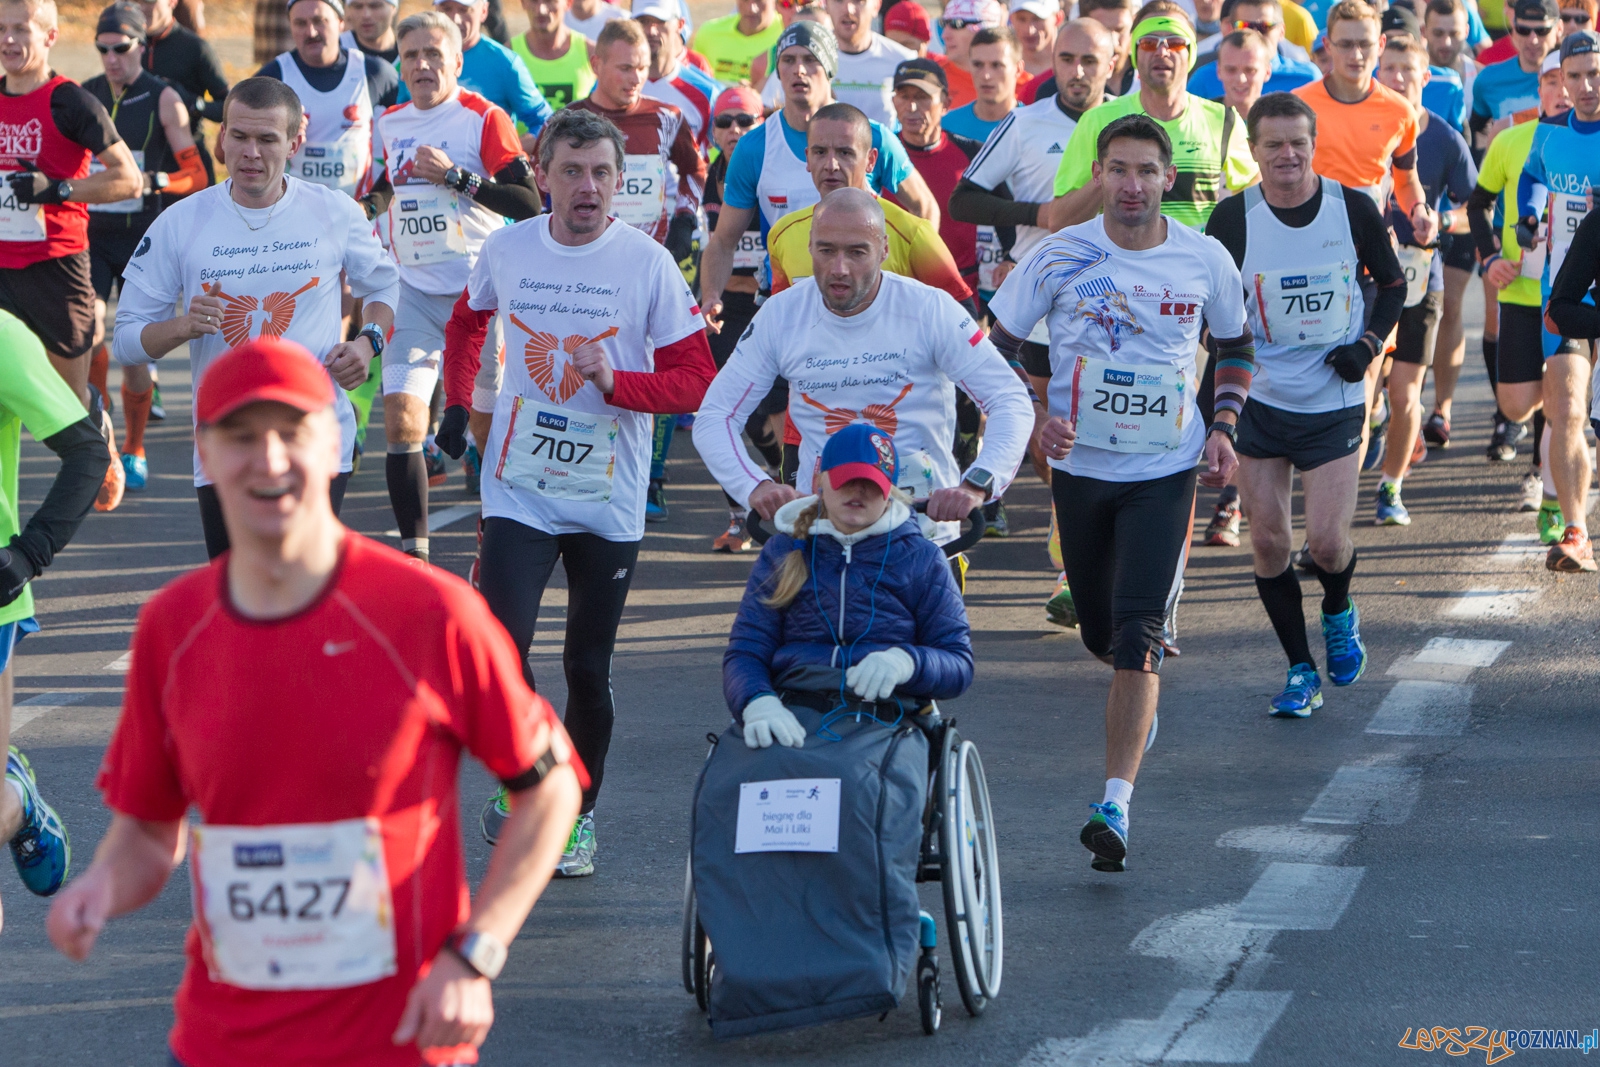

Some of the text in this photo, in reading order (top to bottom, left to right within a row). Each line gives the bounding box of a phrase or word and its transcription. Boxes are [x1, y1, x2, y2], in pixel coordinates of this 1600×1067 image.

[302, 162, 345, 177] 6168
[1549, 172, 1592, 194] KUBA
[399, 214, 447, 236] 7006
[212, 246, 258, 258] Biegamy
[262, 245, 268, 253] z
[200, 268, 244, 280] Biegamy
[248, 263, 269, 275] dla
[519, 278, 562, 293] Biegamy
[565, 285, 571, 293] z
[509, 300, 547, 314] Biegamy
[550, 300, 569, 313] dla
[1160, 302, 1198, 316] KRK
[1282, 291, 1335, 315] 7167
[1178, 316, 1194, 325] 2013
[806, 357, 849, 370] Biegamy
[852, 356, 859, 365] z
[798, 380, 837, 393] Biegamy
[841, 376, 860, 389] dla
[1117, 374, 1133, 383] PKO
[1093, 389, 1168, 417] 2034
[549, 418, 566, 428] PKO
[1115, 422, 1141, 431] Maciej
[531, 433, 594, 464] 7107
[544, 467, 569, 477] Paweł
[762, 810, 812, 823] biegnę dla
[227, 877, 351, 922] 6427
